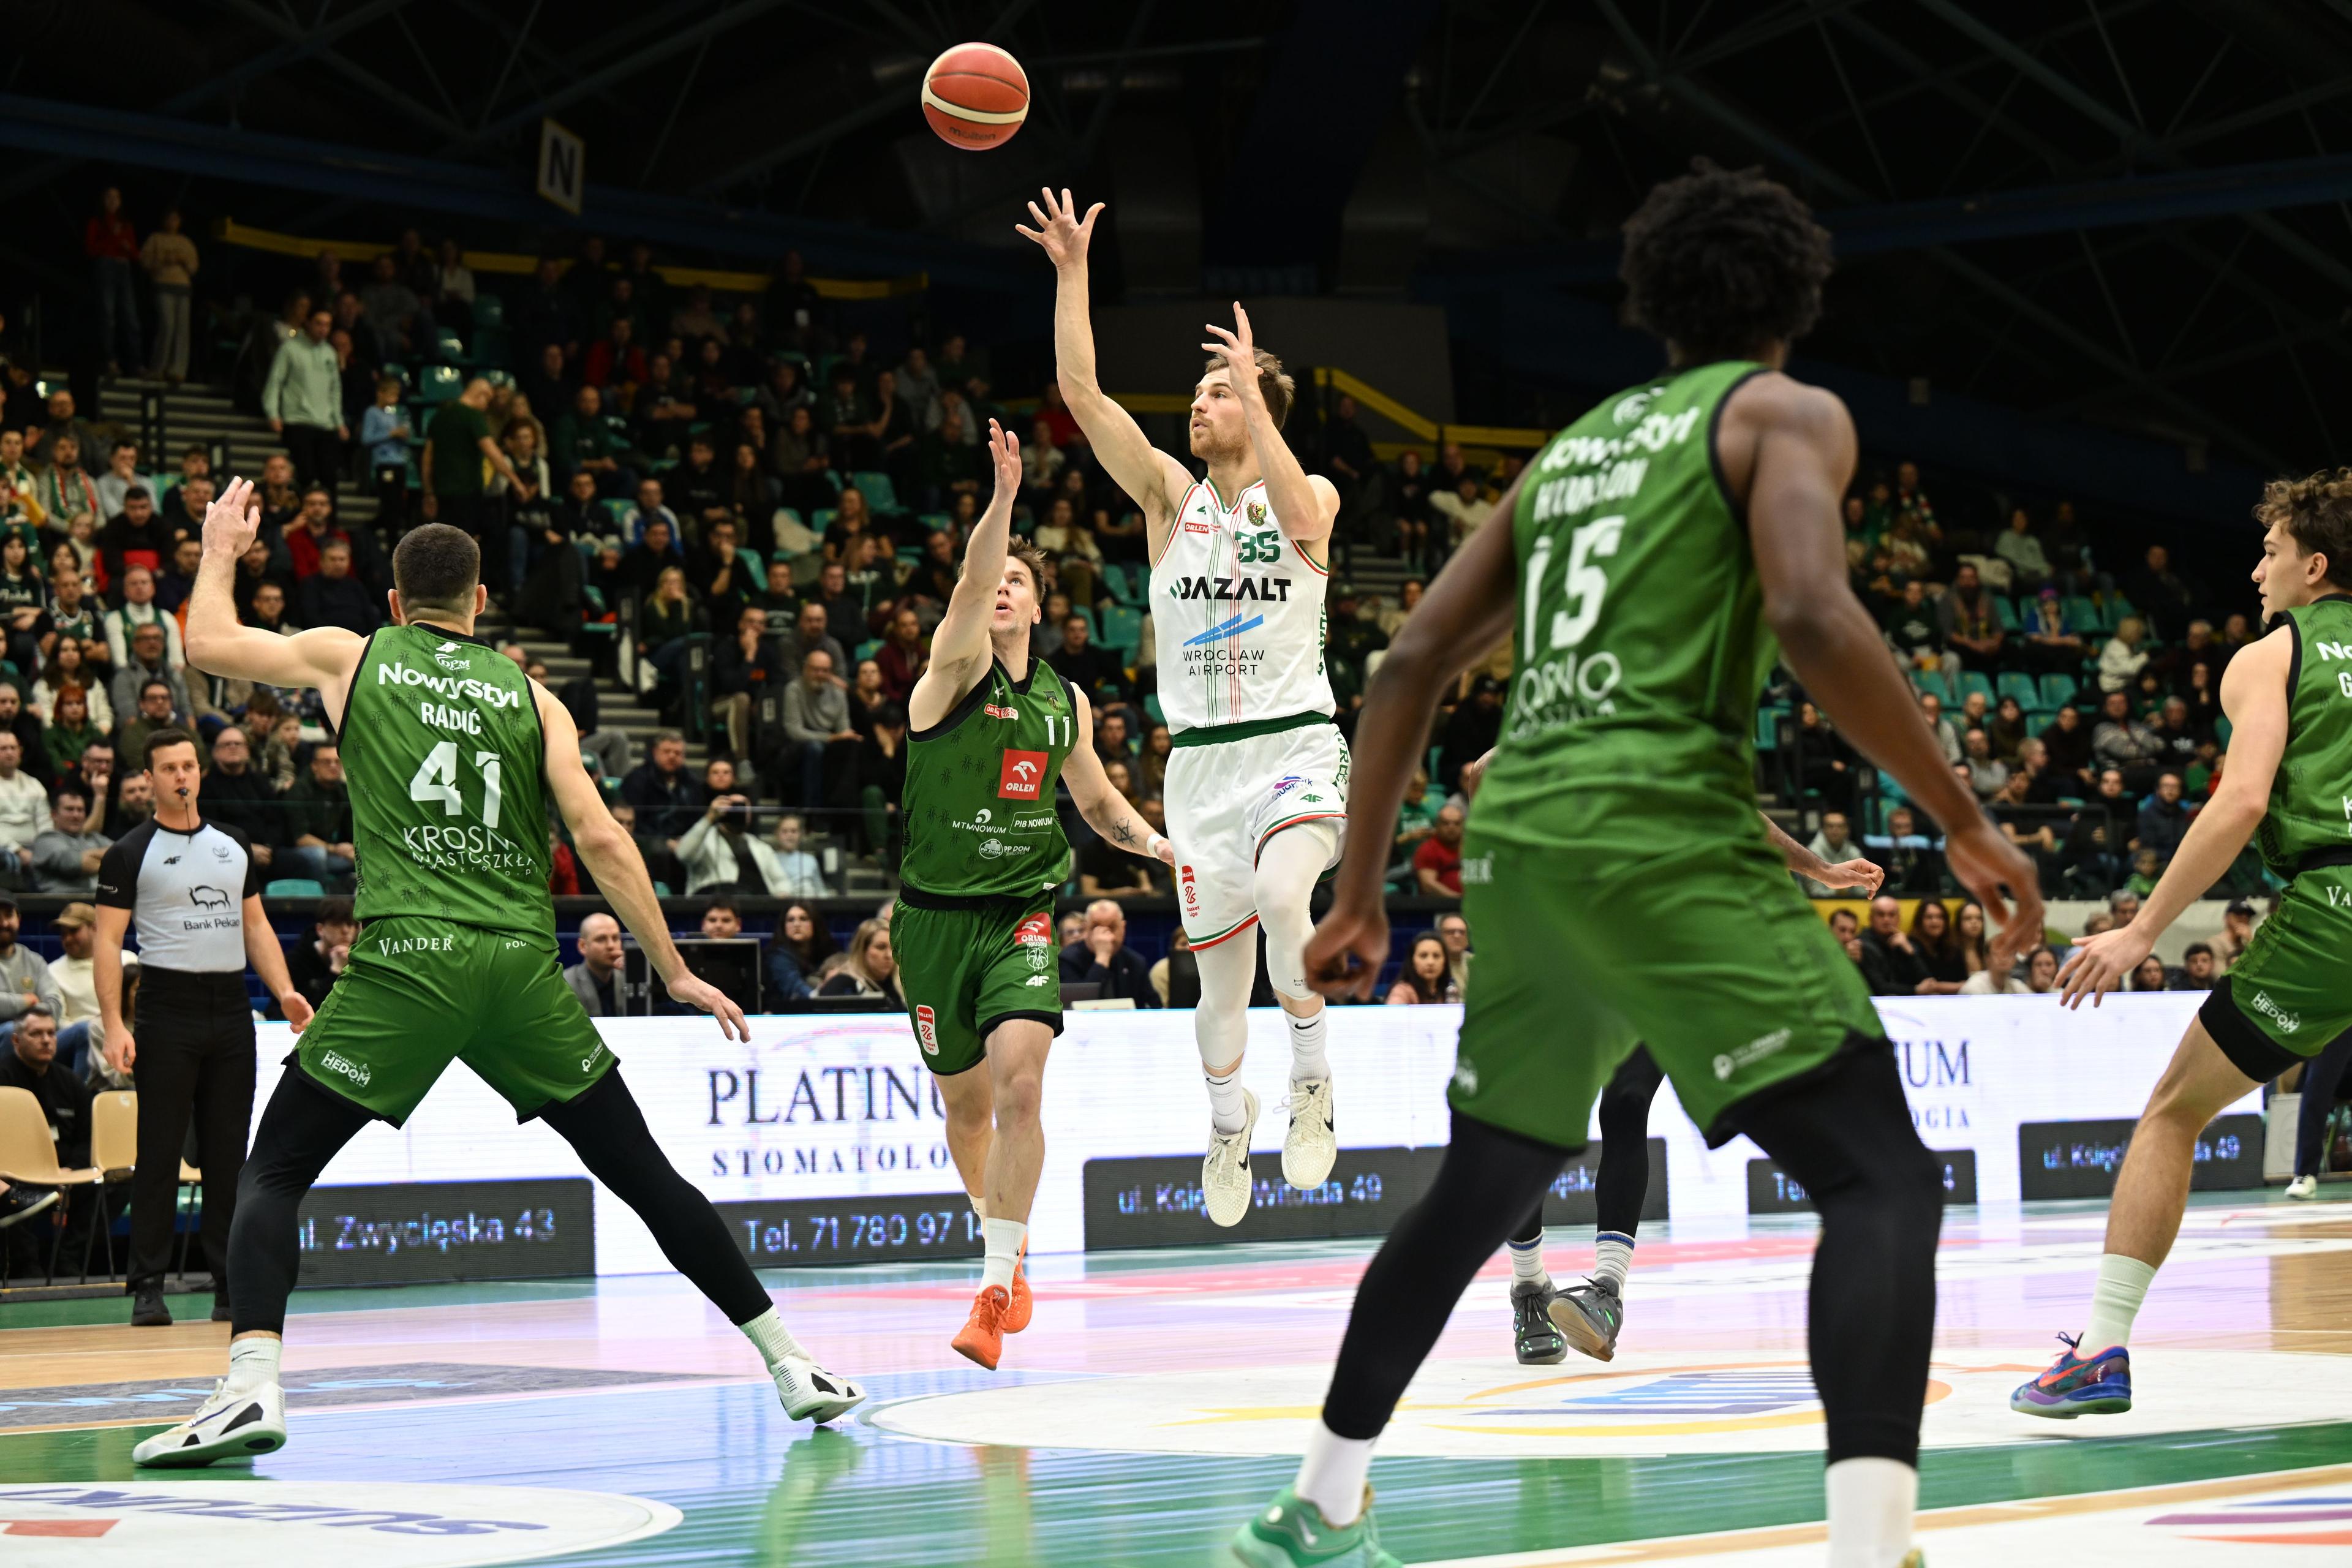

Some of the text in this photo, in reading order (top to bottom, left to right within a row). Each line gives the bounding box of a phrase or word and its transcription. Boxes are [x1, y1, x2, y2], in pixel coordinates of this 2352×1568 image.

[549, 136, 576, 198] N
[1235, 530, 1281, 563] 35
[1180, 576, 1291, 601] BAZALT
[1524, 515, 1626, 663] 15
[1183, 649, 1265, 662] WROCLAW
[1189, 665, 1258, 676] AIRPORT
[421, 702, 481, 735] RADIĆ
[1044, 715, 1069, 747] 11
[410, 741, 501, 829] 41
[1006, 782, 1035, 793] ORLEN
[1028, 817, 1053, 827] NOWUM
[403, 825, 519, 853] KROSN
[184, 918, 239, 930] Bank Pekao
[1020, 934, 1047, 943] ORLEN
[2251, 992, 2299, 1033] HEDOM
[322, 1053, 371, 1086] HEDOM
[710, 1142, 950, 1177] STOMATOLO
[1118, 1185, 1149, 1214] ul.
[1349, 1172, 1382, 1202] 49
[745, 1218, 799, 1254] Tel.
[810, 1216, 840, 1250] 71
[851, 1213, 907, 1248] 780
[916, 1211, 954, 1244] 97
